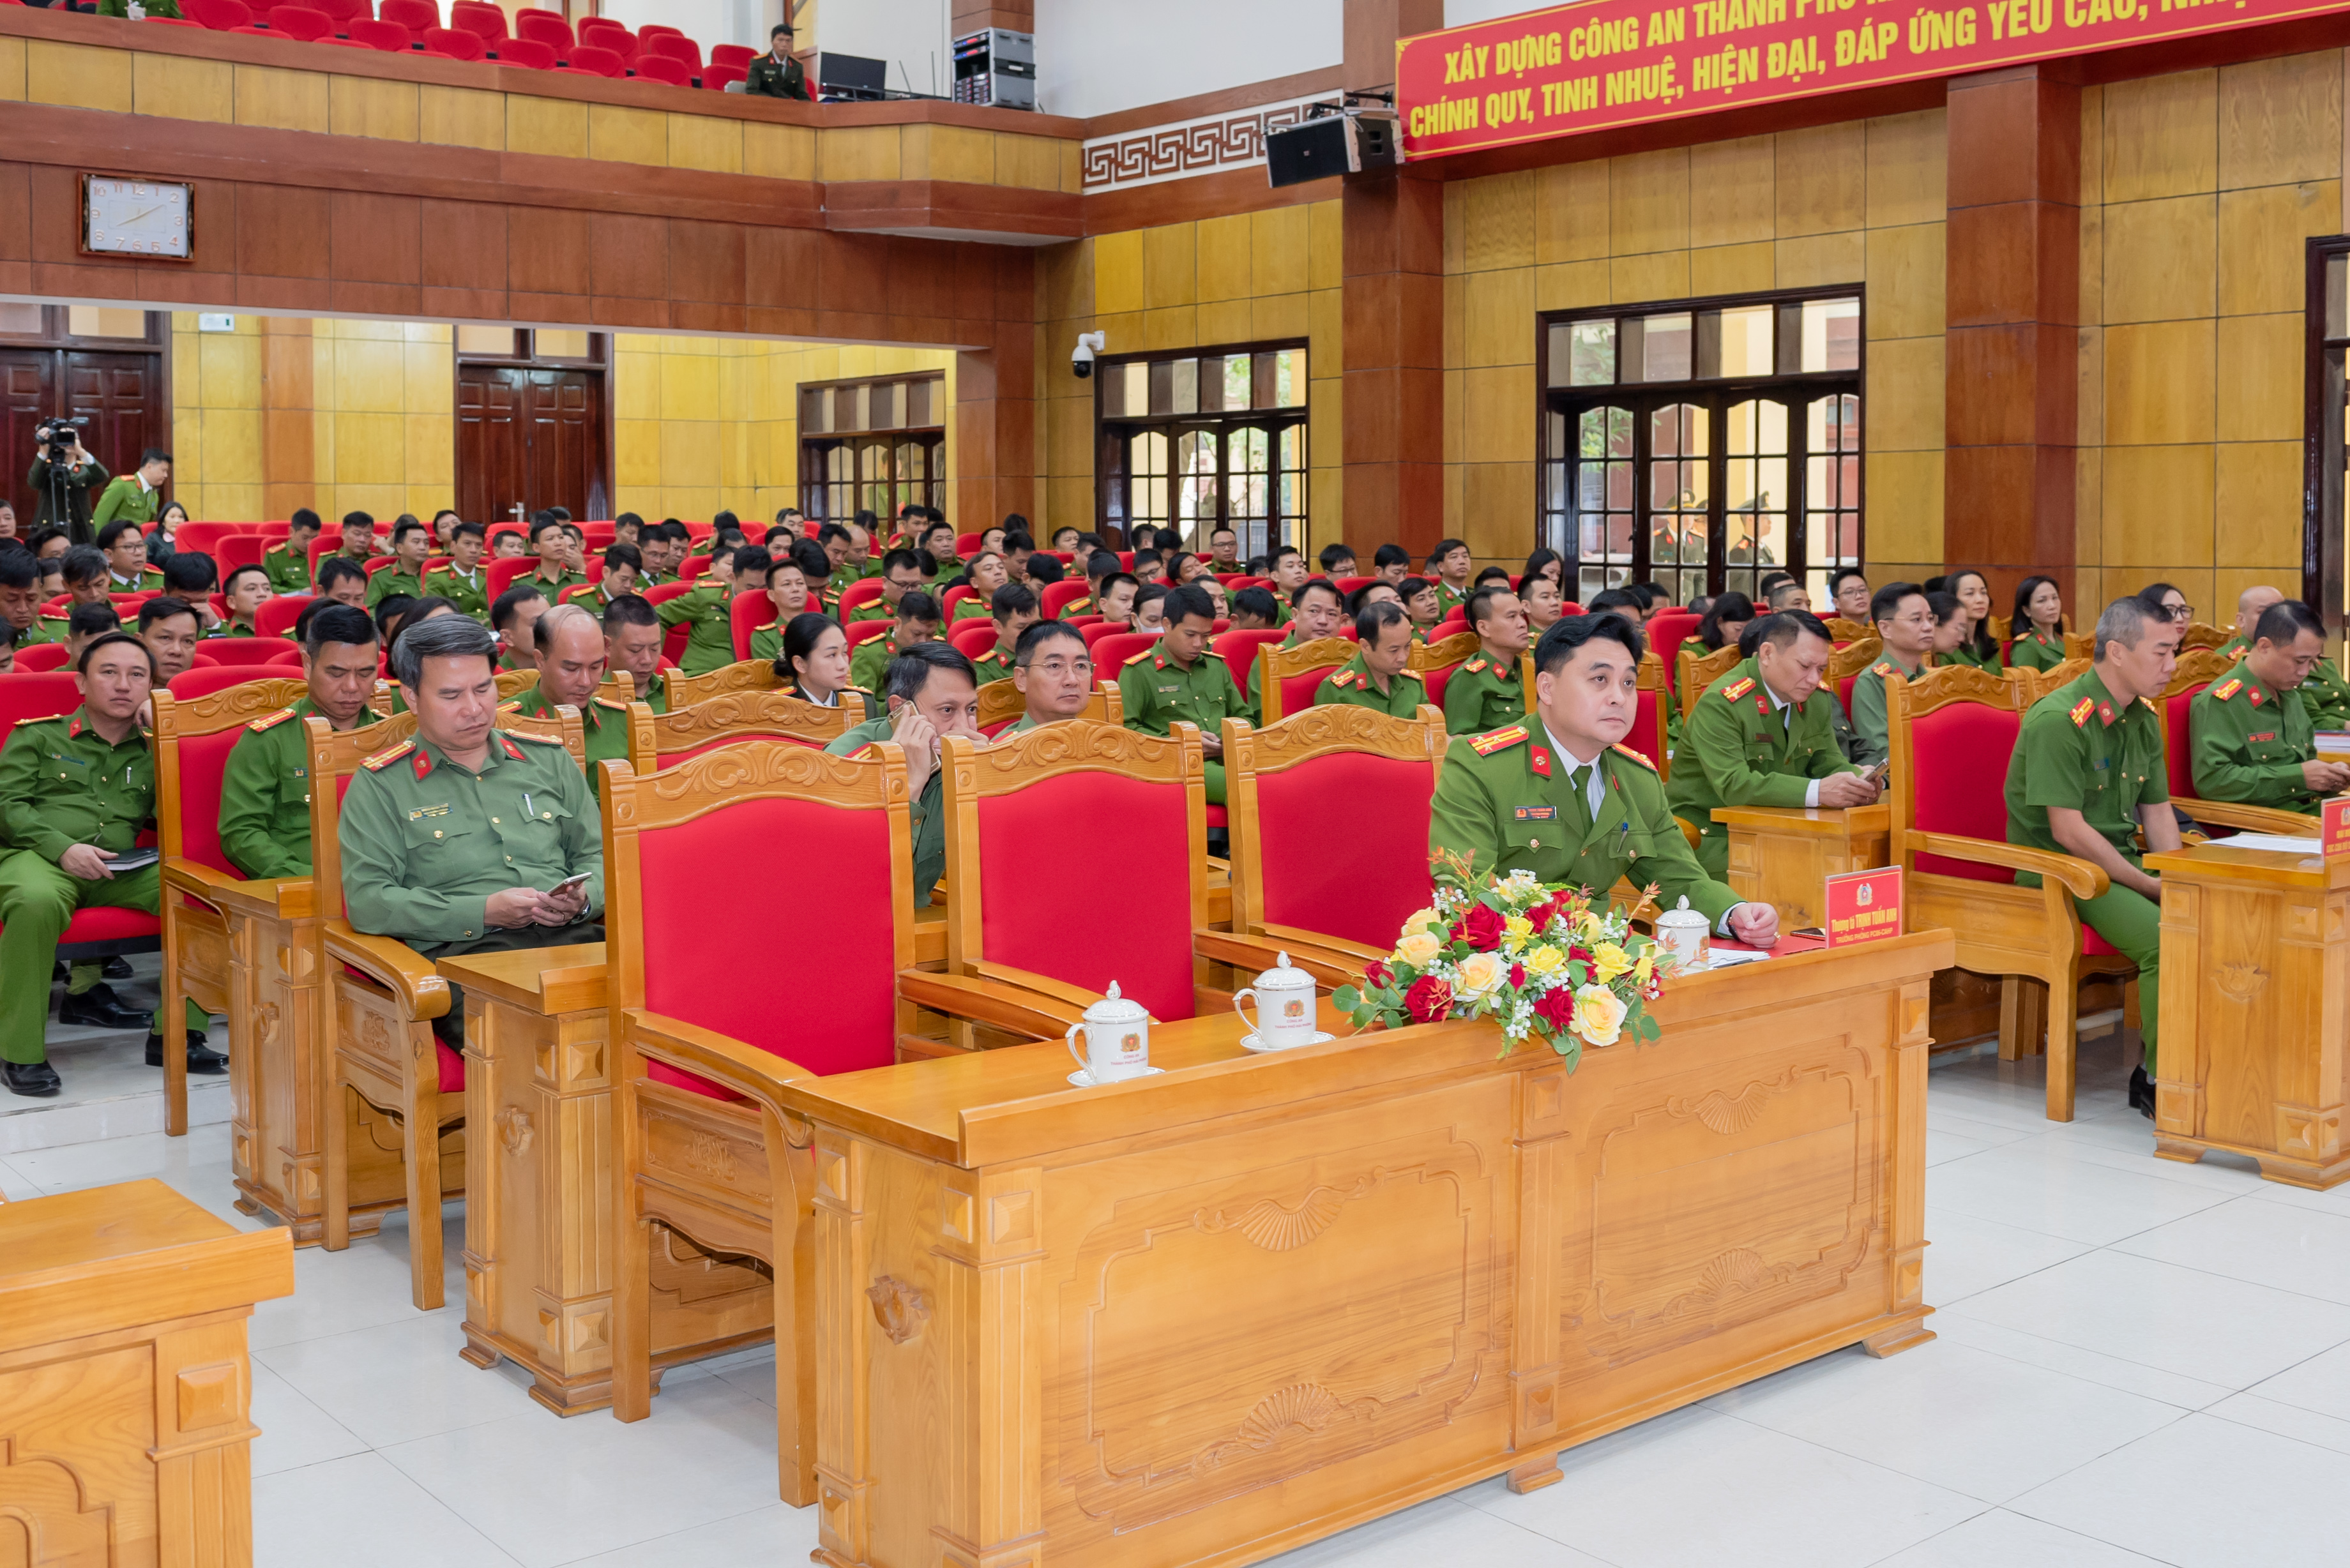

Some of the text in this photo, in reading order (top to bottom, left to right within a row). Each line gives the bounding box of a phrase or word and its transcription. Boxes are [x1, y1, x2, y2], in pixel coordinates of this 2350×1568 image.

[1444, 42, 1489, 84] XÂY
[1496, 32, 1562, 79] DỰNG
[1569, 17, 1639, 61] CÔNG
[1646, 7, 1685, 47] AN
[1410, 95, 1478, 138] CHÍNH
[1485, 87, 1534, 128] QUY,
[1541, 75, 1598, 117] TINH
[1605, 55, 1684, 105] NHUỆ,
[1692, 43, 1759, 94] HIỆN
[1766, 36, 1826, 82] ĐẠI,
[1835, 17, 1899, 67] ĐÁP
[1909, 7, 1976, 54] ỨNG
[93, 185, 106, 197] 10
[113, 182, 123, 193] 11
[132, 183, 145, 195] 12
[169, 192, 179, 203] 2
[91, 207, 100, 219] 9
[174, 215, 183, 225] 3
[116, 237, 125, 249] 7
[133, 239, 142, 251] 6
[151, 241, 160, 252] 5
[169, 235, 178, 246] 4
